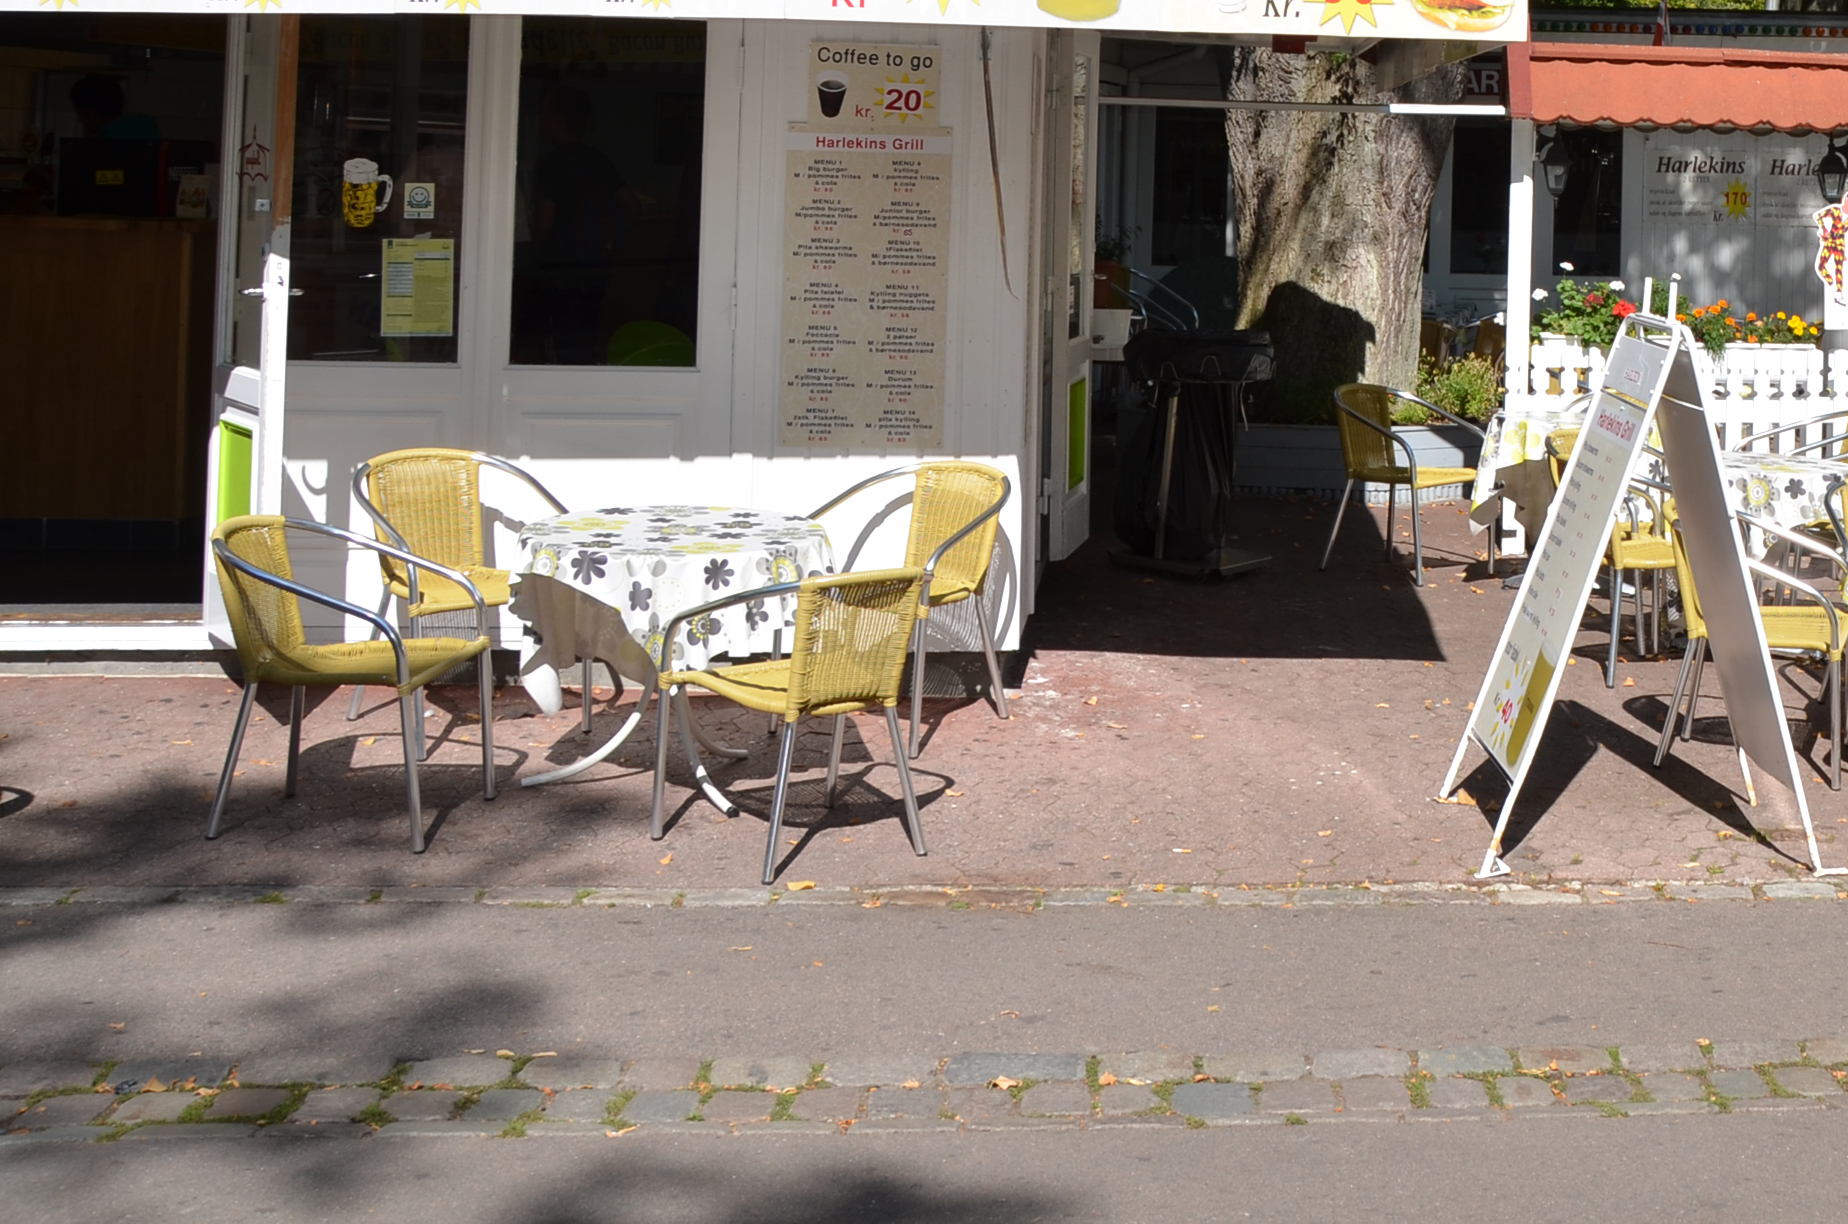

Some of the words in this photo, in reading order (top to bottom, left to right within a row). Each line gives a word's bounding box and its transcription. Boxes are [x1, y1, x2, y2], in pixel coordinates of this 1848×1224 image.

[817, 46, 879, 66] Coffee
[886, 52, 903, 67] to
[910, 56, 933, 71] go
[855, 105, 874, 120] kr.
[884, 88, 922, 112] 20
[815, 136, 887, 150] Harlekins
[892, 138, 924, 151] Grill
[1656, 156, 1746, 175] Harlekins
[1724, 192, 1748, 206] 170
[1596, 408, 1623, 436] Harlekins
[1620, 419, 1637, 443] Grill
